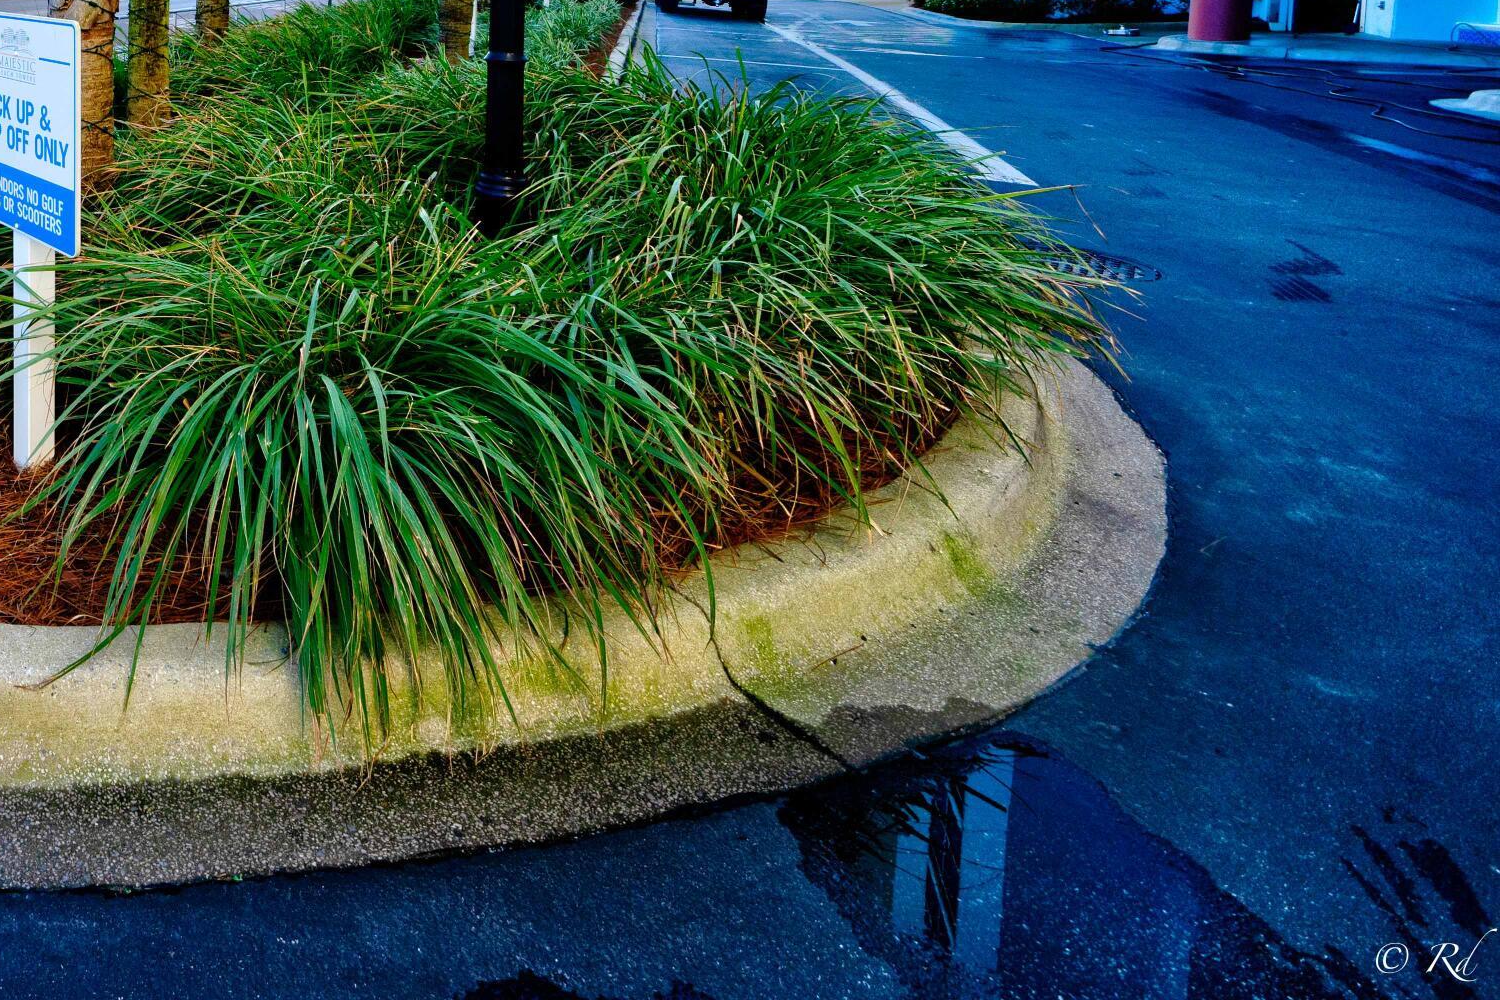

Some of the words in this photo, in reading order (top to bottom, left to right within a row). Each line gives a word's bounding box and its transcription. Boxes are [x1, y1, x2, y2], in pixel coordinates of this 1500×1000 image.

[16, 98, 34, 125] UP
[40, 105, 51, 132] &
[7, 125, 29, 154] OFF
[34, 134, 69, 168] ONLY
[3, 196, 14, 214] OR
[17, 202, 62, 236] SCOOTERS
[26, 187, 38, 206] NO
[41, 194, 64, 216] GOLF
